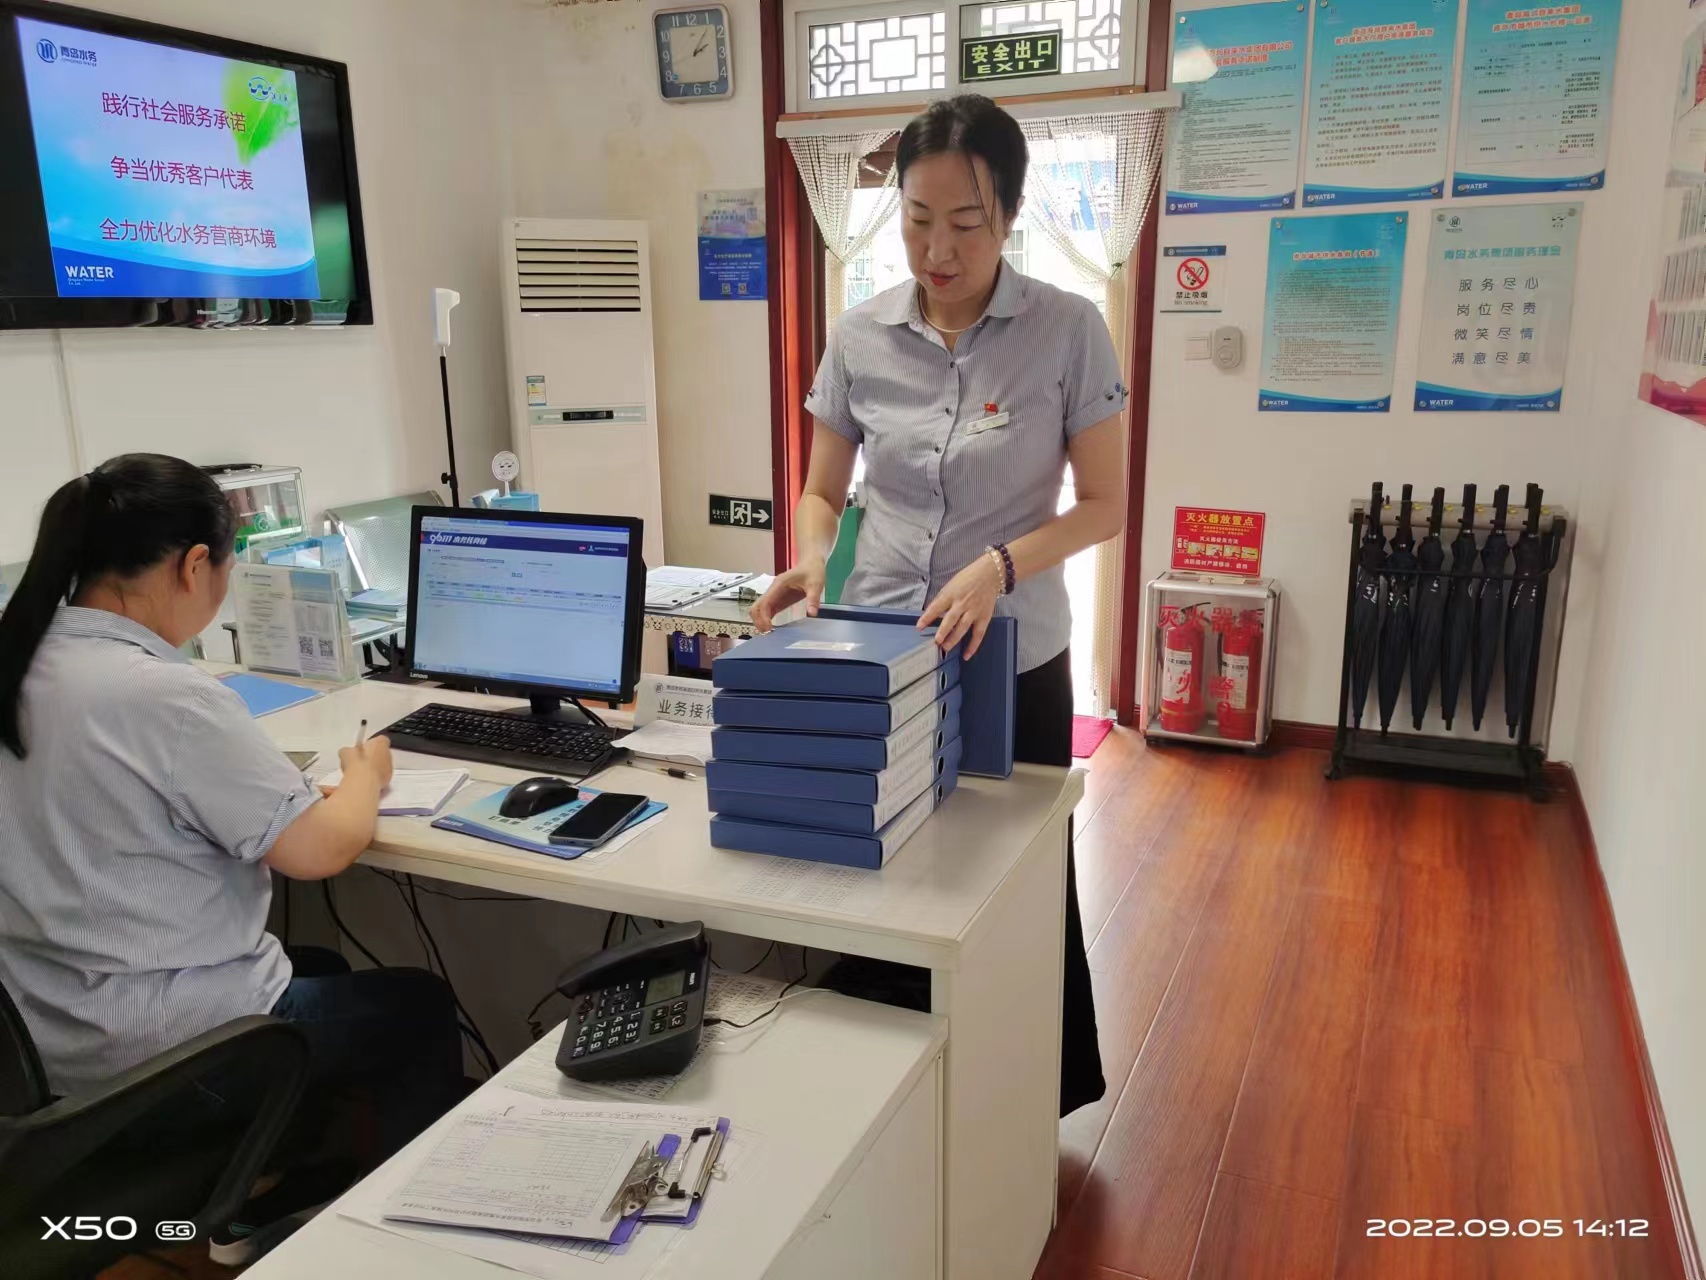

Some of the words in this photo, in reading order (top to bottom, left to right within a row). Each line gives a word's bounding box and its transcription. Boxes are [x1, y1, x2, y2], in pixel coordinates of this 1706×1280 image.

[671, 15, 680, 27] 11
[686, 14, 698, 26] 12
[704, 12, 710, 25] 1
[660, 31, 670, 42] 10
[716, 26, 725, 37] 2
[662, 51, 670, 62] 9
[718, 46, 727, 58] 3
[971, 40, 1052, 64] 安全出口
[720, 67, 728, 78] 4
[977, 59, 1045, 74] EXIT
[665, 71, 673, 82] 8
[679, 84, 685, 95] 7
[693, 83, 702, 95] 6
[709, 82, 717, 93] 5
[101, 92, 247, 133] 践行社会服务承诺
[110, 155, 254, 191] 争当优秀客户代表
[99, 217, 277, 249] 全力优化水务营商环境
[65, 265, 115, 279] WATER
[1458, 277, 1539, 292] 服务尽心
[1175, 291, 1208, 299] 禁止吸烟
[1456, 302, 1537, 317] 岗位尽责
[1453, 327, 1534, 341] 微笑尽情
[1451, 352, 1532, 365] 满意尽美
[1185, 512, 1254, 527] 灭火器放置点
